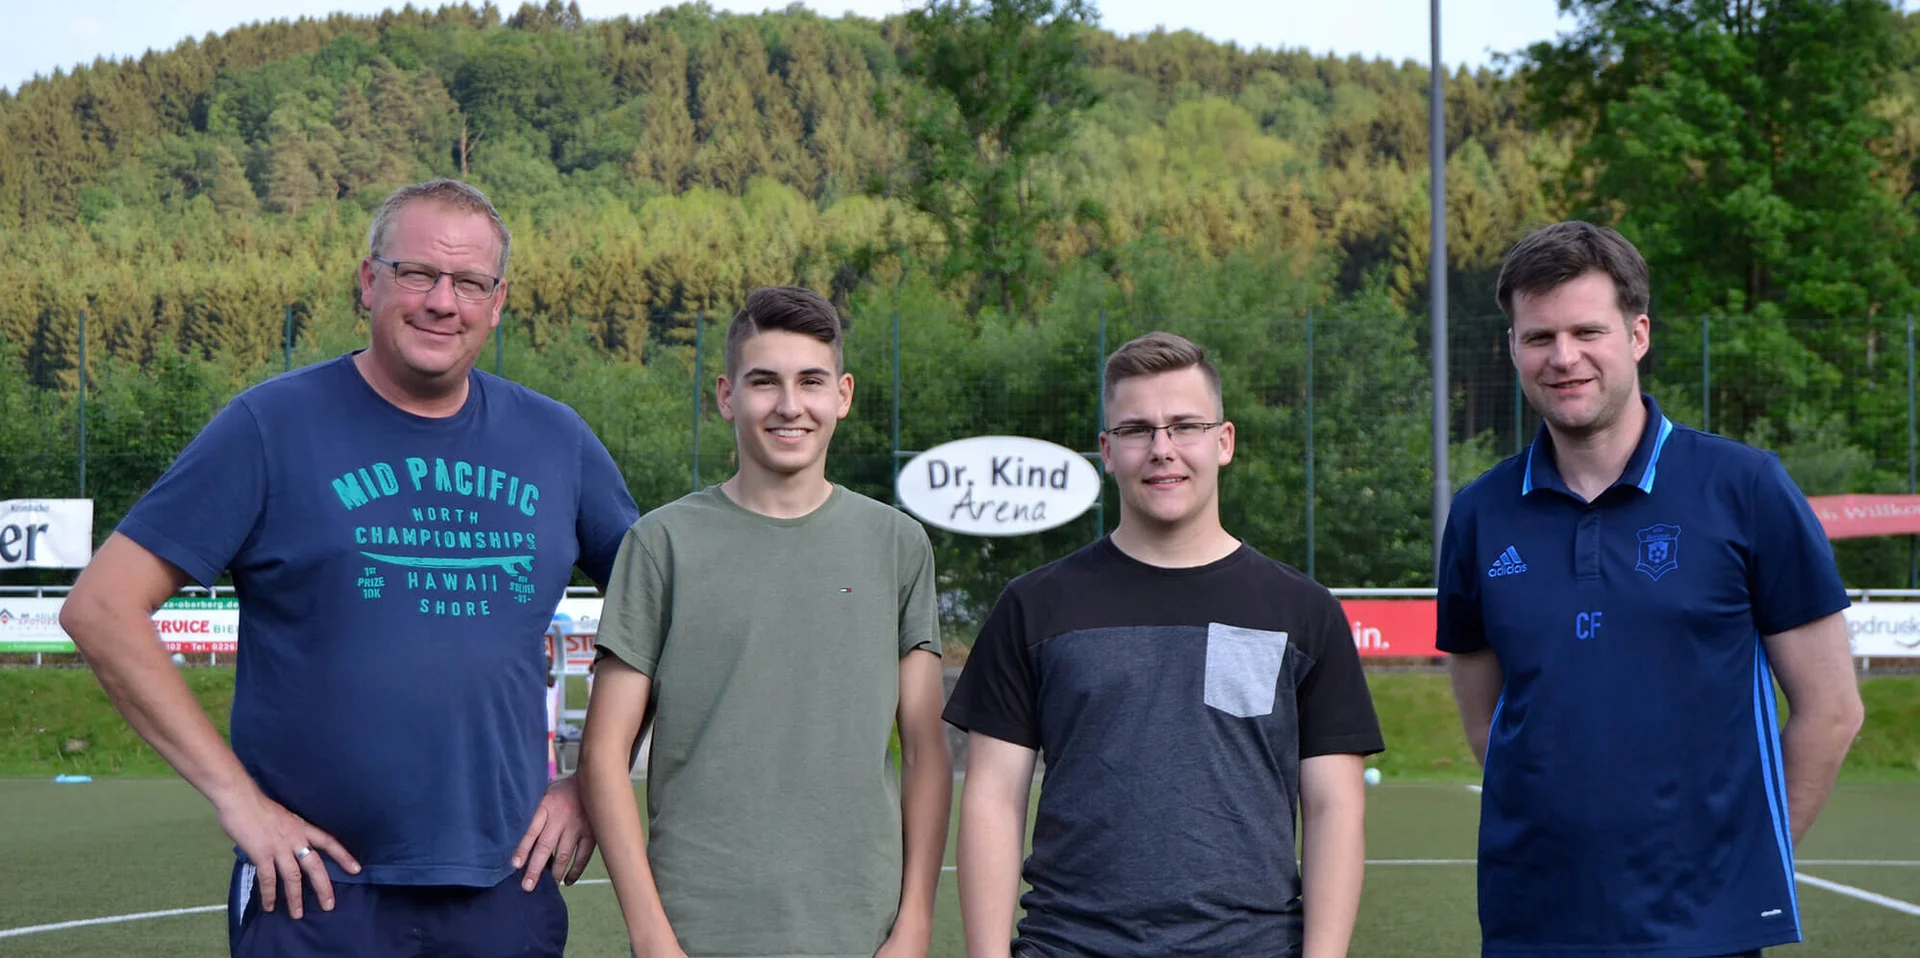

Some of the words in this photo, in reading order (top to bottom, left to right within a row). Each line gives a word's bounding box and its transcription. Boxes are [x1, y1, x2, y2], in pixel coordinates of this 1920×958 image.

[927, 459, 974, 489] Dr.
[991, 456, 1069, 489] Kind
[331, 461, 400, 511] MID
[405, 456, 540, 517] PACIFIC
[411, 506, 479, 525] NORTH
[950, 486, 1047, 523] Arena
[0, 523, 49, 563] er
[354, 525, 537, 551] CHAMPIONSHIPS
[357, 576, 386, 588] PRIZE
[407, 570, 498, 593] HAWAII
[1487, 562, 1529, 578] adidas
[362, 588, 382, 599] 10K
[419, 597, 491, 617] SHORE
[1576, 611, 1603, 640] CF
